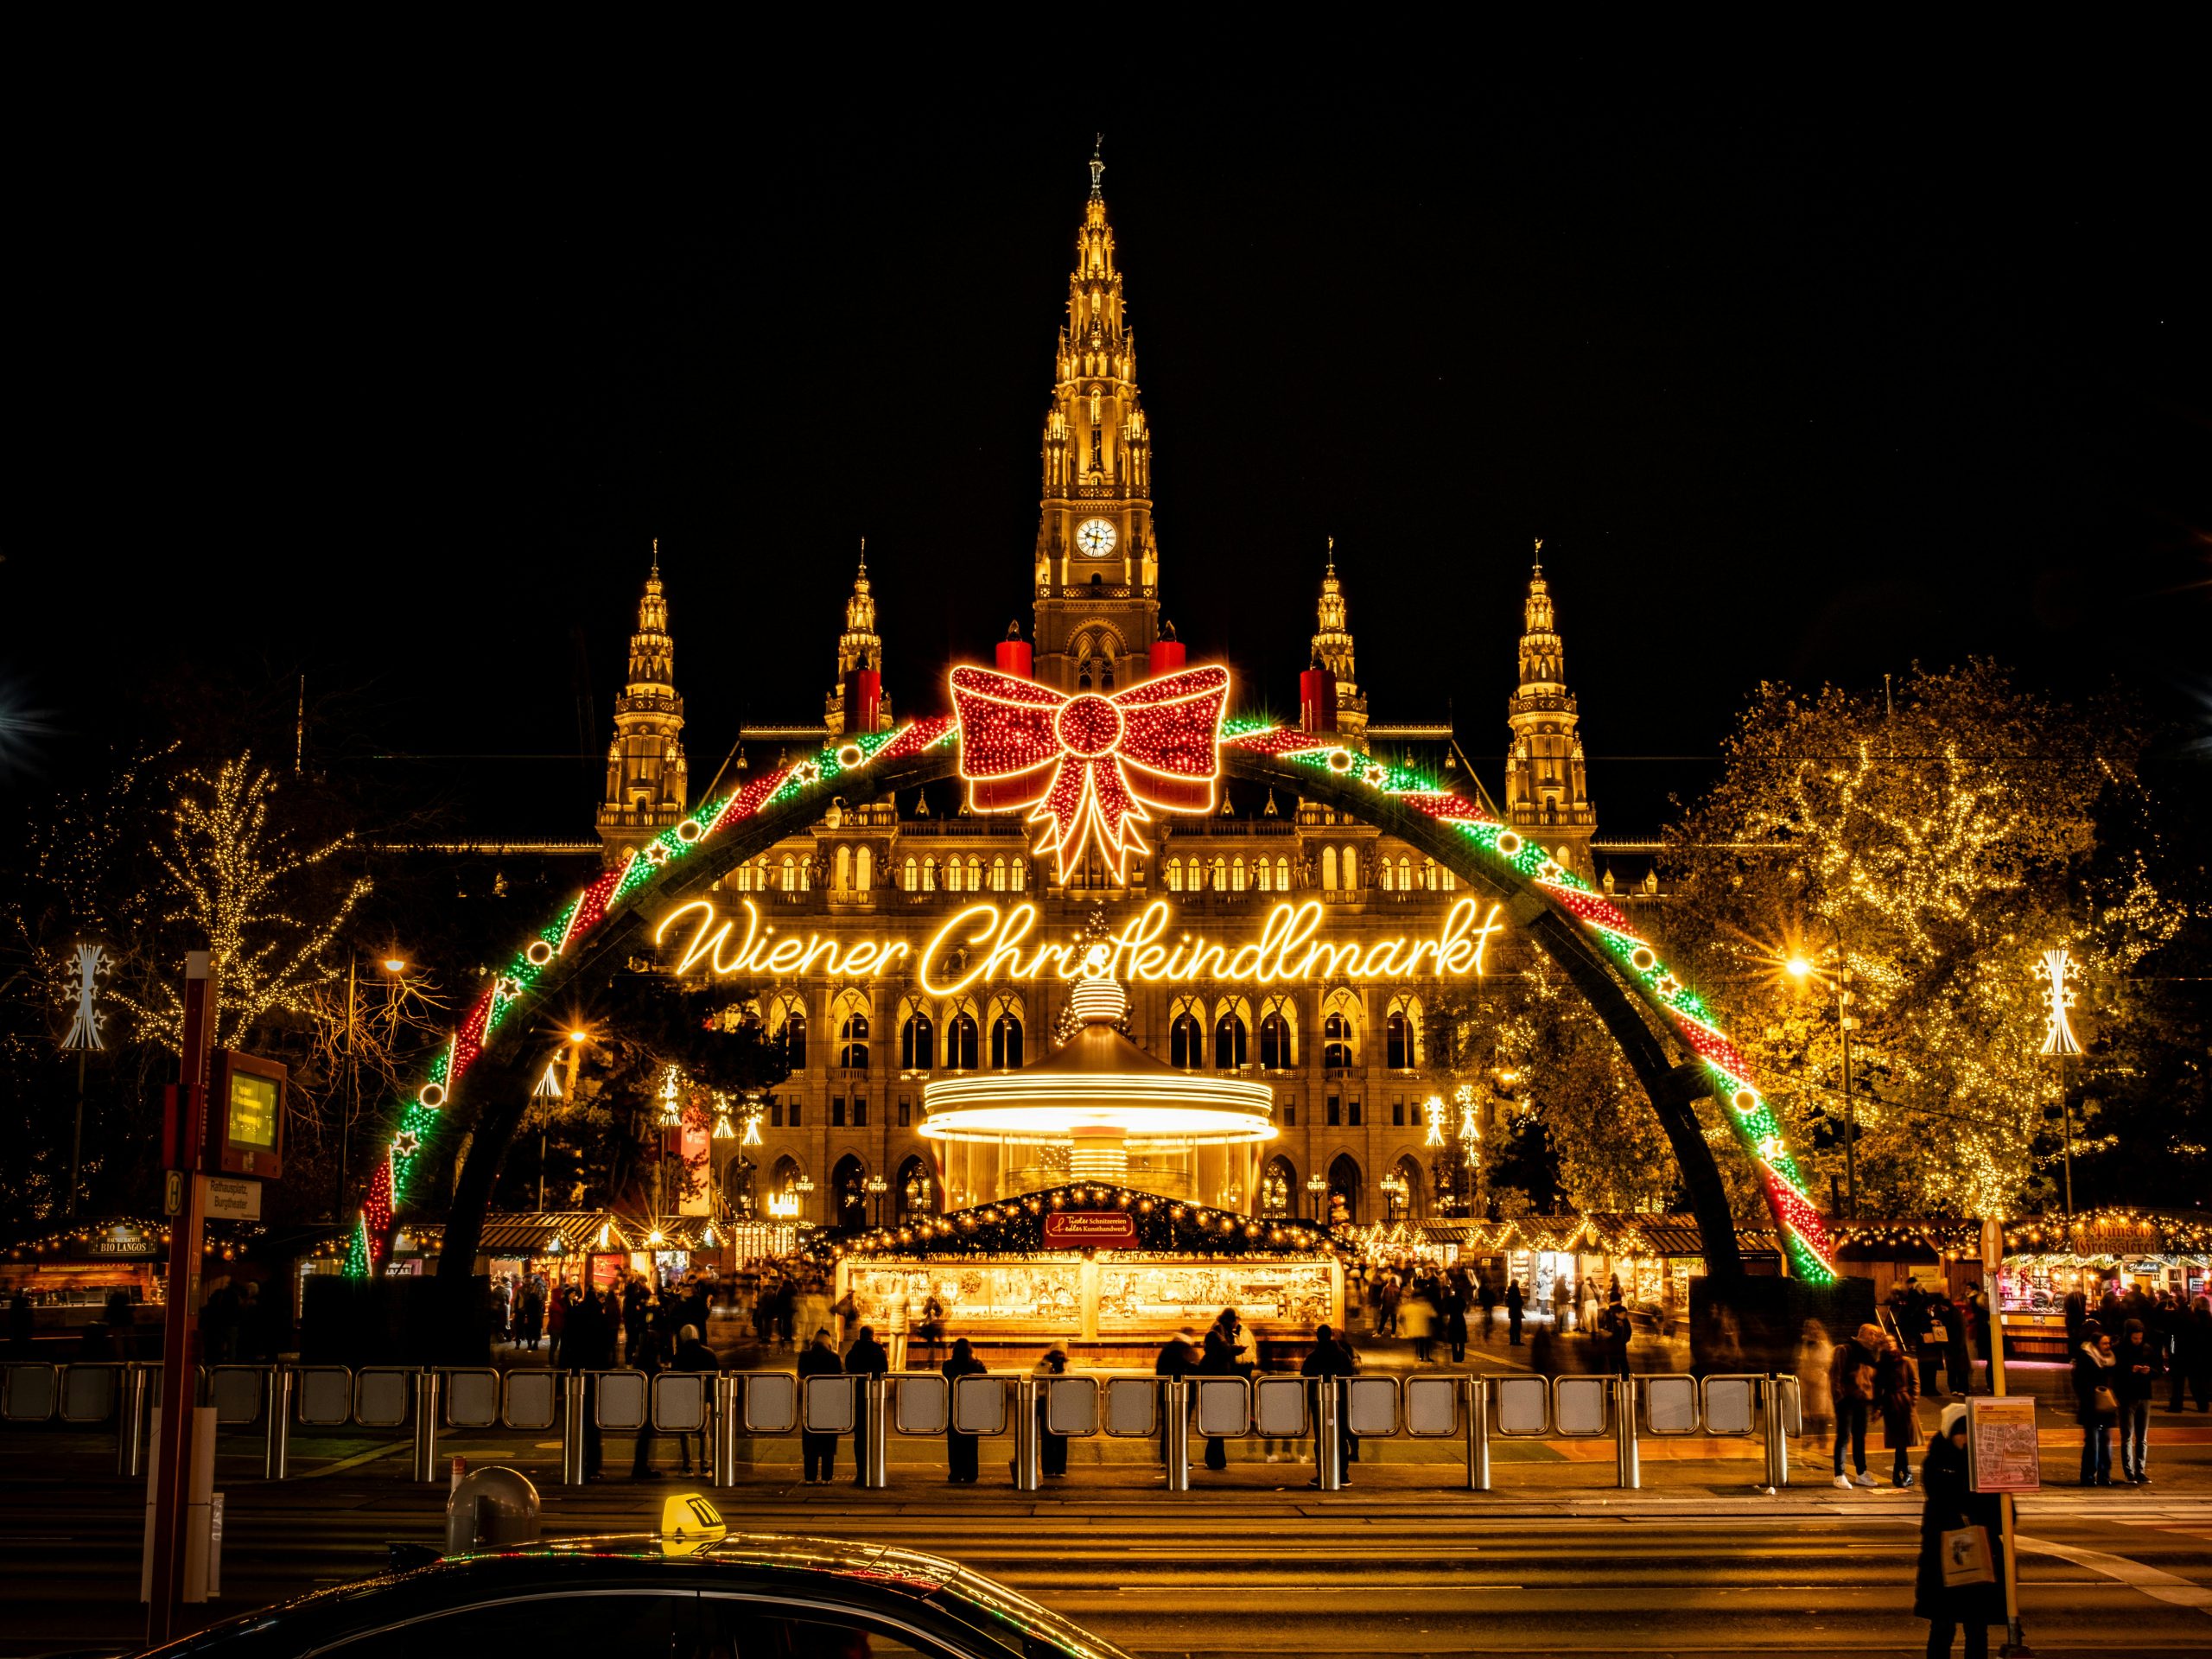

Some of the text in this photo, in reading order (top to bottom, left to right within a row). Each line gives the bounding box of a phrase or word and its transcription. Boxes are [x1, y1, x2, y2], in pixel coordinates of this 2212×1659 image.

[655, 898, 1504, 996] Wiener Christkindlmarkt
[200, 1030, 213, 1147] WIENER LINIEN
[169, 1179, 179, 1206] H
[210, 1179, 248, 1197] Rathausplatz,
[214, 1196, 248, 1211] Burgtheater
[2089, 1223, 2152, 1241] Punsch
[100, 1243, 147, 1252] BIO LANGOS
[2075, 1236, 2156, 1257] Greisslerei
